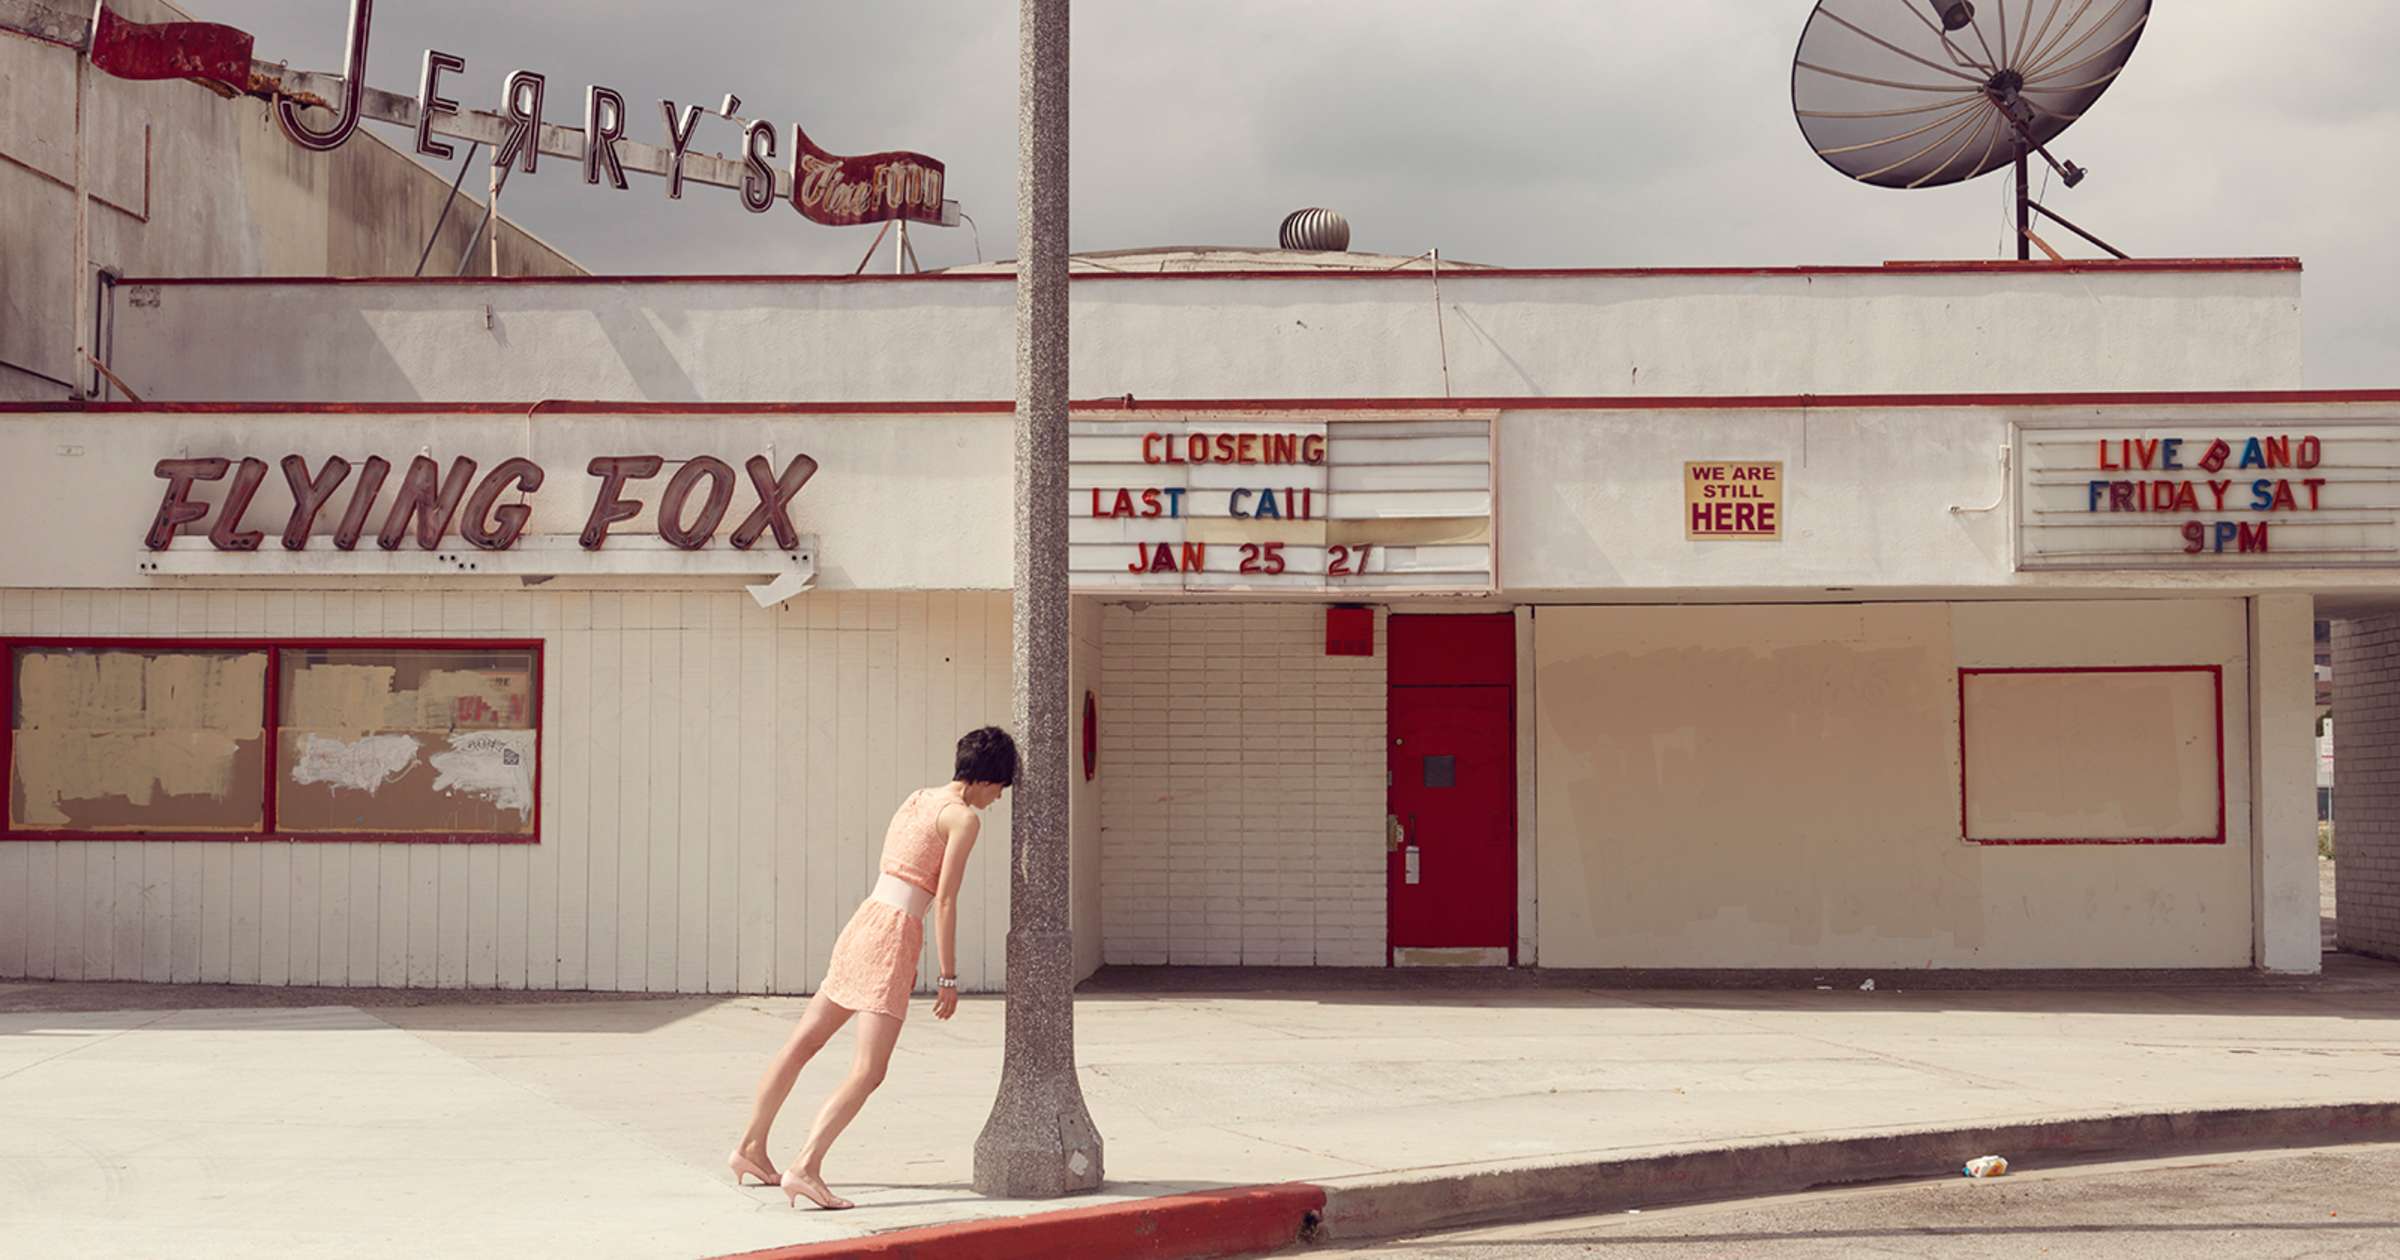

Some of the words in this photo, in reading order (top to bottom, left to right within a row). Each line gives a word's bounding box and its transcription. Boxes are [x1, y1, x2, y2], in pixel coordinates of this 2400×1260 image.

[1141, 431, 1325, 466] CLOSEING
[2099, 438, 2183, 471] LIVE
[1692, 466, 1725, 481] WE
[1732, 466, 1776, 481] ARE
[144, 454, 545, 552] FLYING
[578, 453, 818, 551] FOX
[1091, 487, 1186, 519] LAST
[1703, 484, 1764, 498] STILL
[2089, 479, 2232, 512] FRIDAY
[2250, 478, 2326, 512] SAT
[1692, 502, 1775, 531] HERE
[1128, 541, 1205, 575] JAN
[1239, 541, 1285, 575] 25
[1328, 543, 1374, 577] 27
